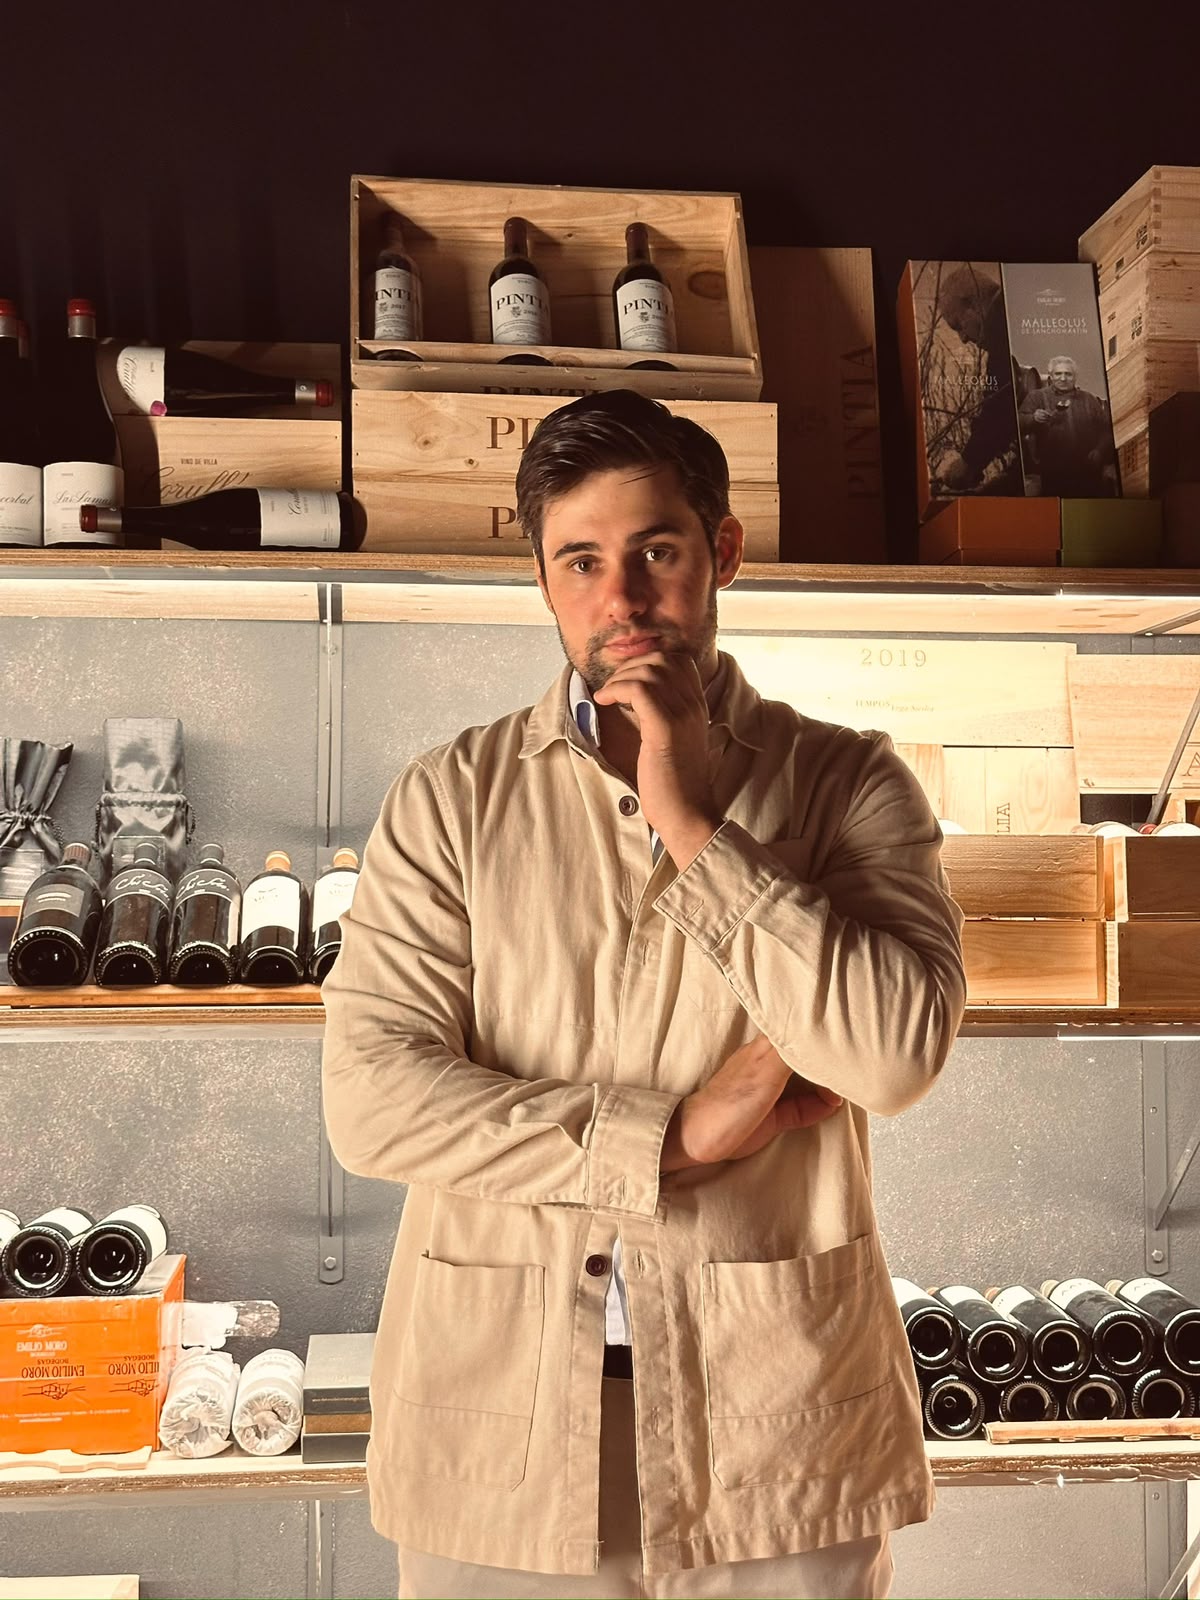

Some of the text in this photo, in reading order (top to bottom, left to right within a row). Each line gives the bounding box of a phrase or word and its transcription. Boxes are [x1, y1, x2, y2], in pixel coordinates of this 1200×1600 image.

[376, 288, 411, 301] INTI
[496, 293, 543, 310] PINTI
[623, 298, 669, 315] PINTI
[1021, 318, 1087, 328] MALLEOLUS
[840, 345, 880, 500] PINTIA
[203, 458, 218, 466] VILLA
[860, 647, 927, 668] 2019
[996, 802, 1010, 833] LIA
[21, 1364, 85, 1379] EMILIO MORO
[108, 1361, 160, 1376] ILIO MORO
